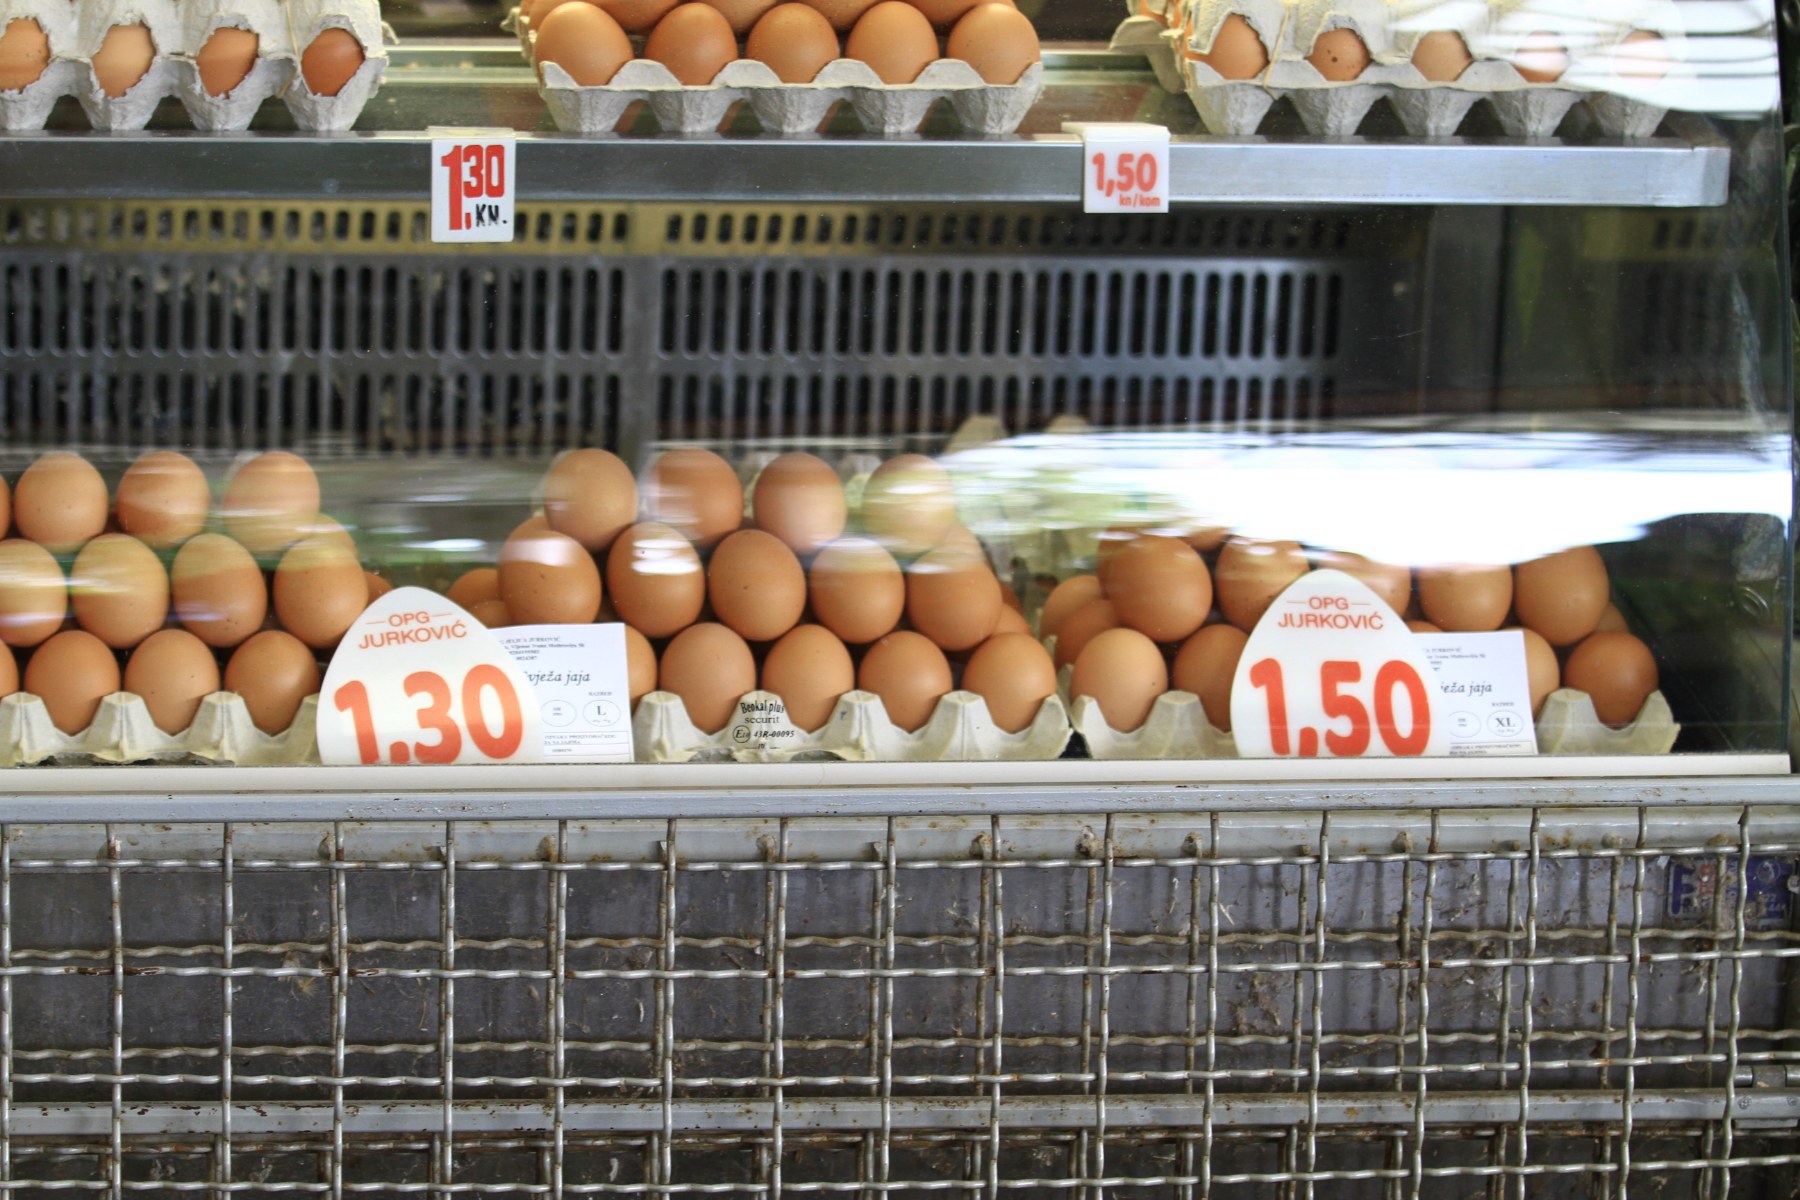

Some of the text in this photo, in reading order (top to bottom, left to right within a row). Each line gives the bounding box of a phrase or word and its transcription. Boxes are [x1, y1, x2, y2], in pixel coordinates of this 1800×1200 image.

[1092, 153, 1157, 198] 1,50
[1308, 597, 1349, 610] OPG
[388, 611, 430, 627] OPG
[1278, 612, 1384, 631] JURKOVIĆ
[358, 620, 467, 649] JURKOVIĆ
[523, 670, 591, 686] vježa jaja
[1467, 682, 1492, 697] jaja
[596, 705, 607, 716] L
[768, 699, 786, 715] plus
[1496, 717, 1516, 728] XL
